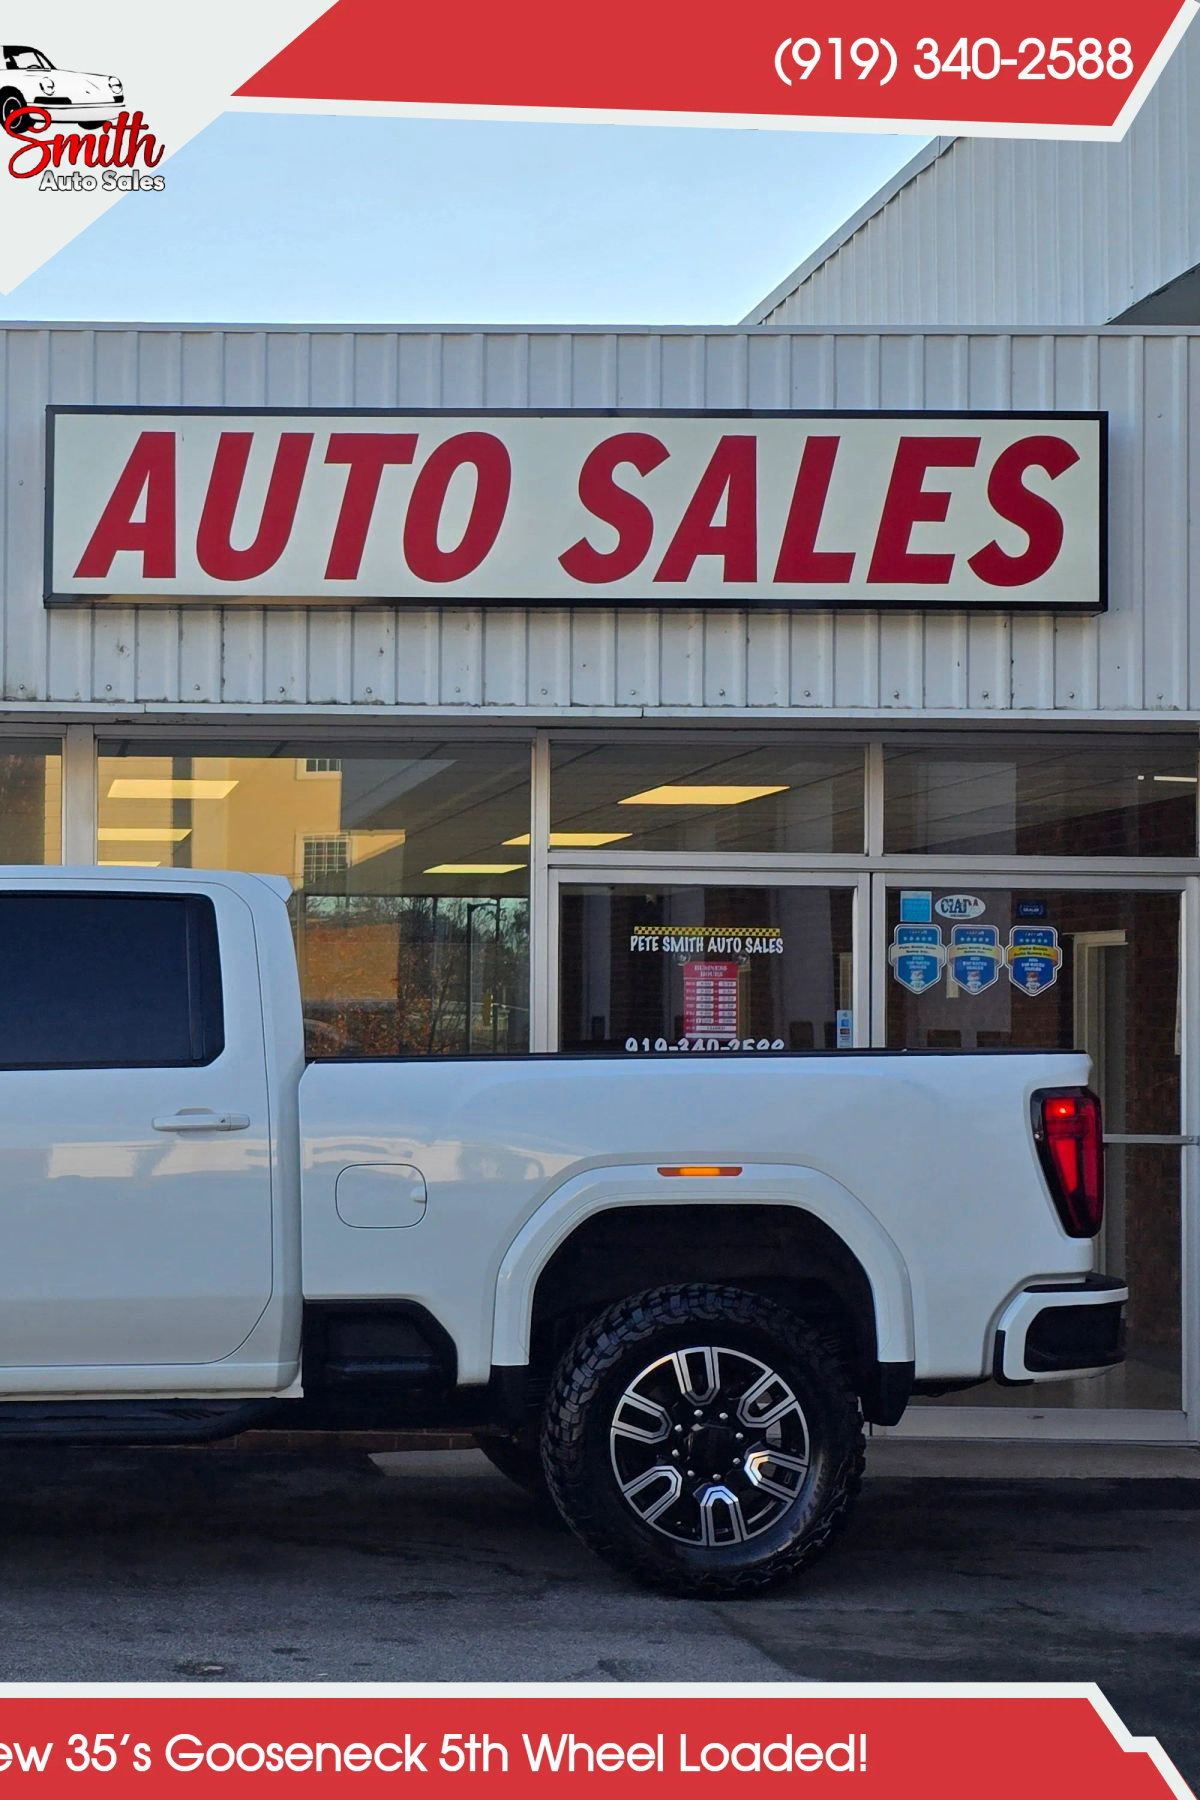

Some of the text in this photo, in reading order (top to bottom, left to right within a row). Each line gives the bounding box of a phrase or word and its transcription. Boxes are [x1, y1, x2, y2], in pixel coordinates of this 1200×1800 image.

[74, 431, 1081, 587] AUTO SALES
[630, 935, 784, 954] PETE SMITH AUTO SALES
